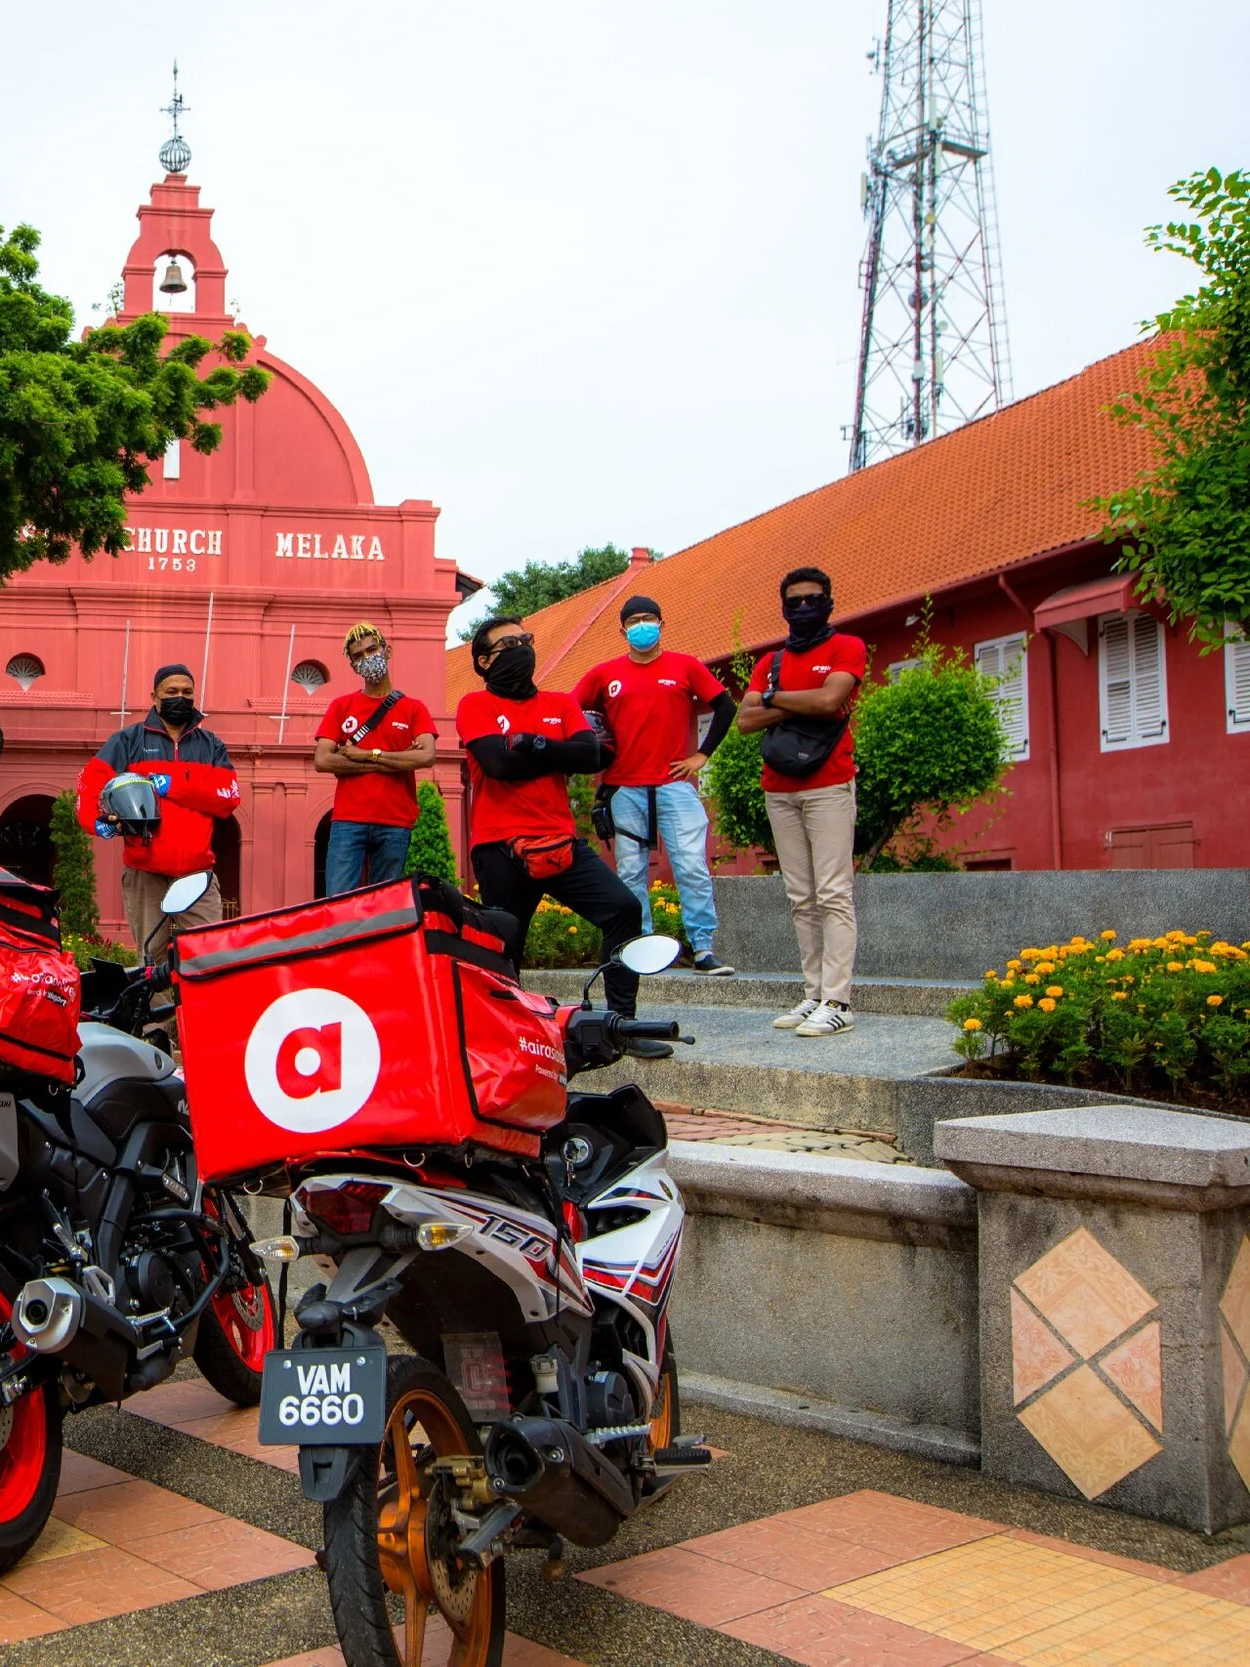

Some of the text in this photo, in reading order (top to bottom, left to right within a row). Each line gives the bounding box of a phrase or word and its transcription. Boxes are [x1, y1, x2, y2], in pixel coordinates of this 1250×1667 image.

[275, 532, 386, 561] MELAKA
[148, 556, 196, 572] 1753
[275, 1021, 342, 1100] a
[478, 1214, 552, 1260] 150
[296, 1362, 350, 1395] VAM
[278, 1393, 364, 1426] 6660
